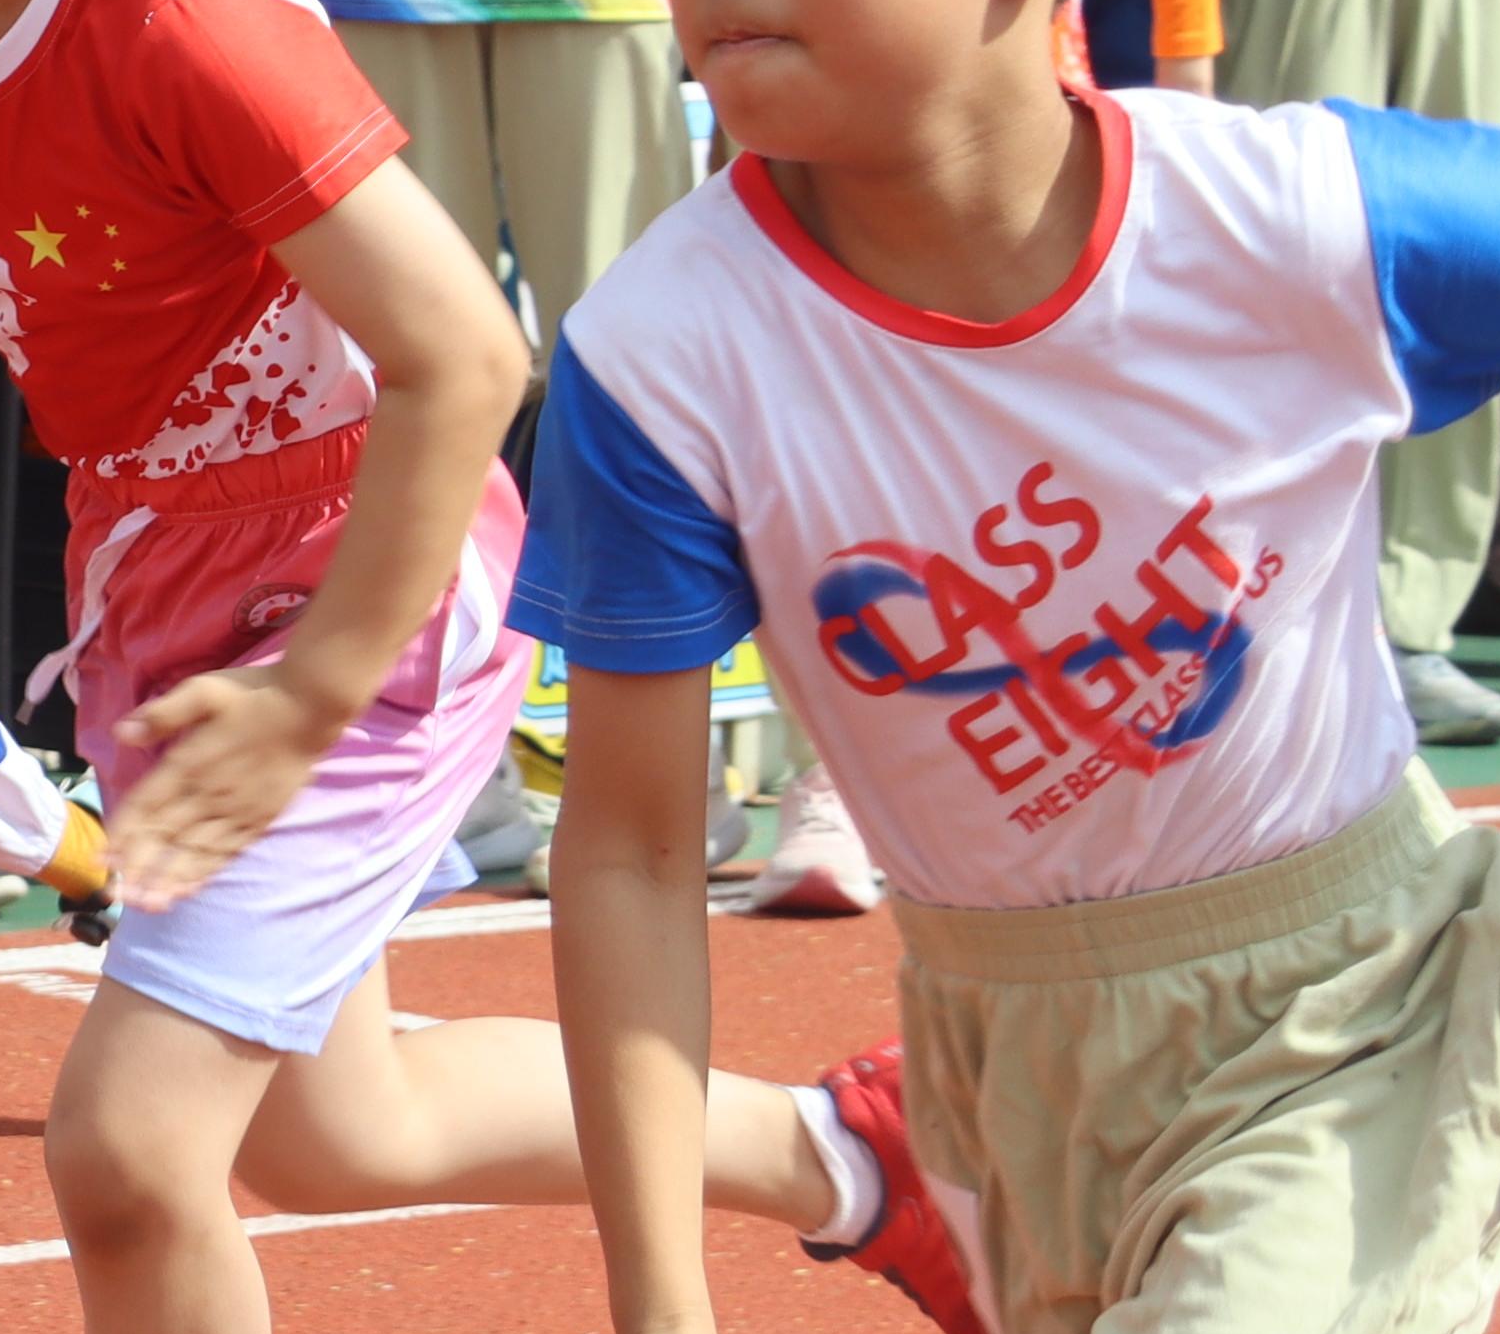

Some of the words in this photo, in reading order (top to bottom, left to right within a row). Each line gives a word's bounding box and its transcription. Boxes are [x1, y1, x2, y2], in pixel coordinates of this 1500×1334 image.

[818, 462, 1101, 698] CLASS
[946, 493, 1243, 797] EIGHT
[1007, 780, 1072, 835] THE
